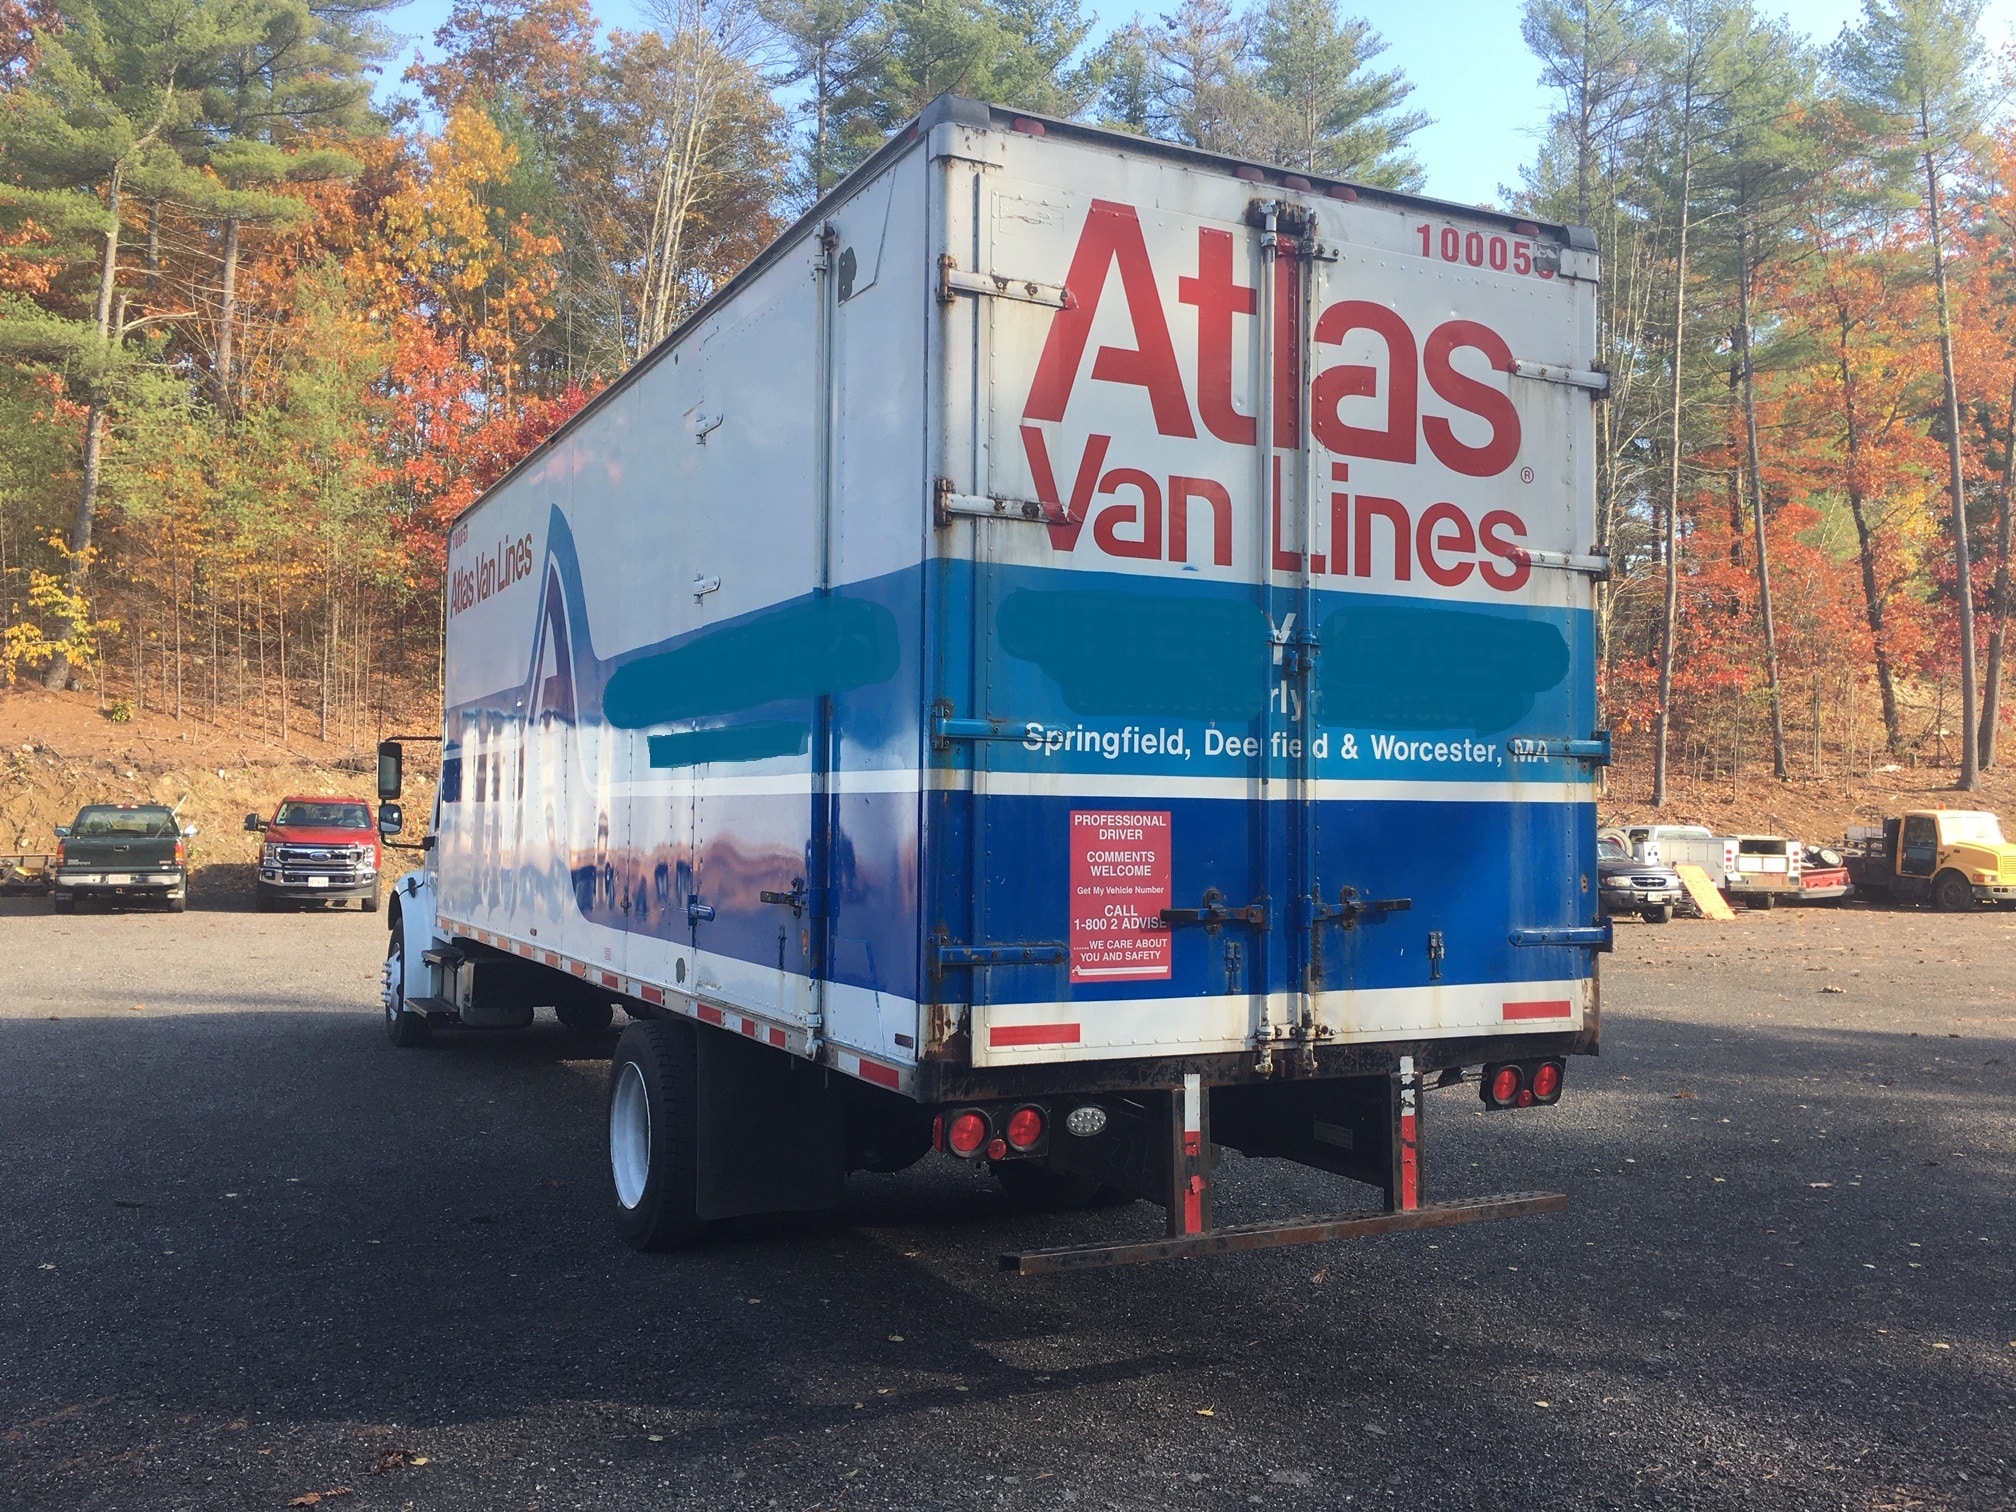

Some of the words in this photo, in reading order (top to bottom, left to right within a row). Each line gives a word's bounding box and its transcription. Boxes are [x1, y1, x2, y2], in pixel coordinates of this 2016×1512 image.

[1022, 198, 1521, 477] Atlas
[1019, 425, 1232, 566] Van
[1268, 455, 1530, 591] Lines
[450, 566, 474, 619] Atlas
[476, 552, 495, 603] Van
[498, 533, 532, 593] Lines
[1022, 722, 1191, 760] Springfield,
[1204, 728, 1328, 759] Deefied
[1341, 733, 1358, 760] &
[1371, 734, 1502, 767] Worcester,
[1514, 739, 1549, 763] MA
[1074, 814, 1166, 826] PROFESSIONAL
[1099, 829, 1143, 840] DRIVER
[1087, 851, 1155, 862] COMMENTS
[1090, 865, 1151, 876] WELCOME
[1077, 886, 1091, 895] Get
[1093, 886, 1105, 896] My
[1106, 886, 1133, 895] Vehicle
[1135, 886, 1165, 895] Number
[1104, 904, 1138, 916] CALL
[1074, 918, 1107, 930] 1-800
[1110, 918, 1118, 930] 2
[1121, 916, 1167, 929] ADVISE
[1106, 939, 1133, 949] CARE
[1135, 938, 1168, 948] ABOUT
[1081, 952, 1100, 961] YOU
[1102, 952, 1122, 961] AND
[1125, 950, 1161, 960] SAFETY
